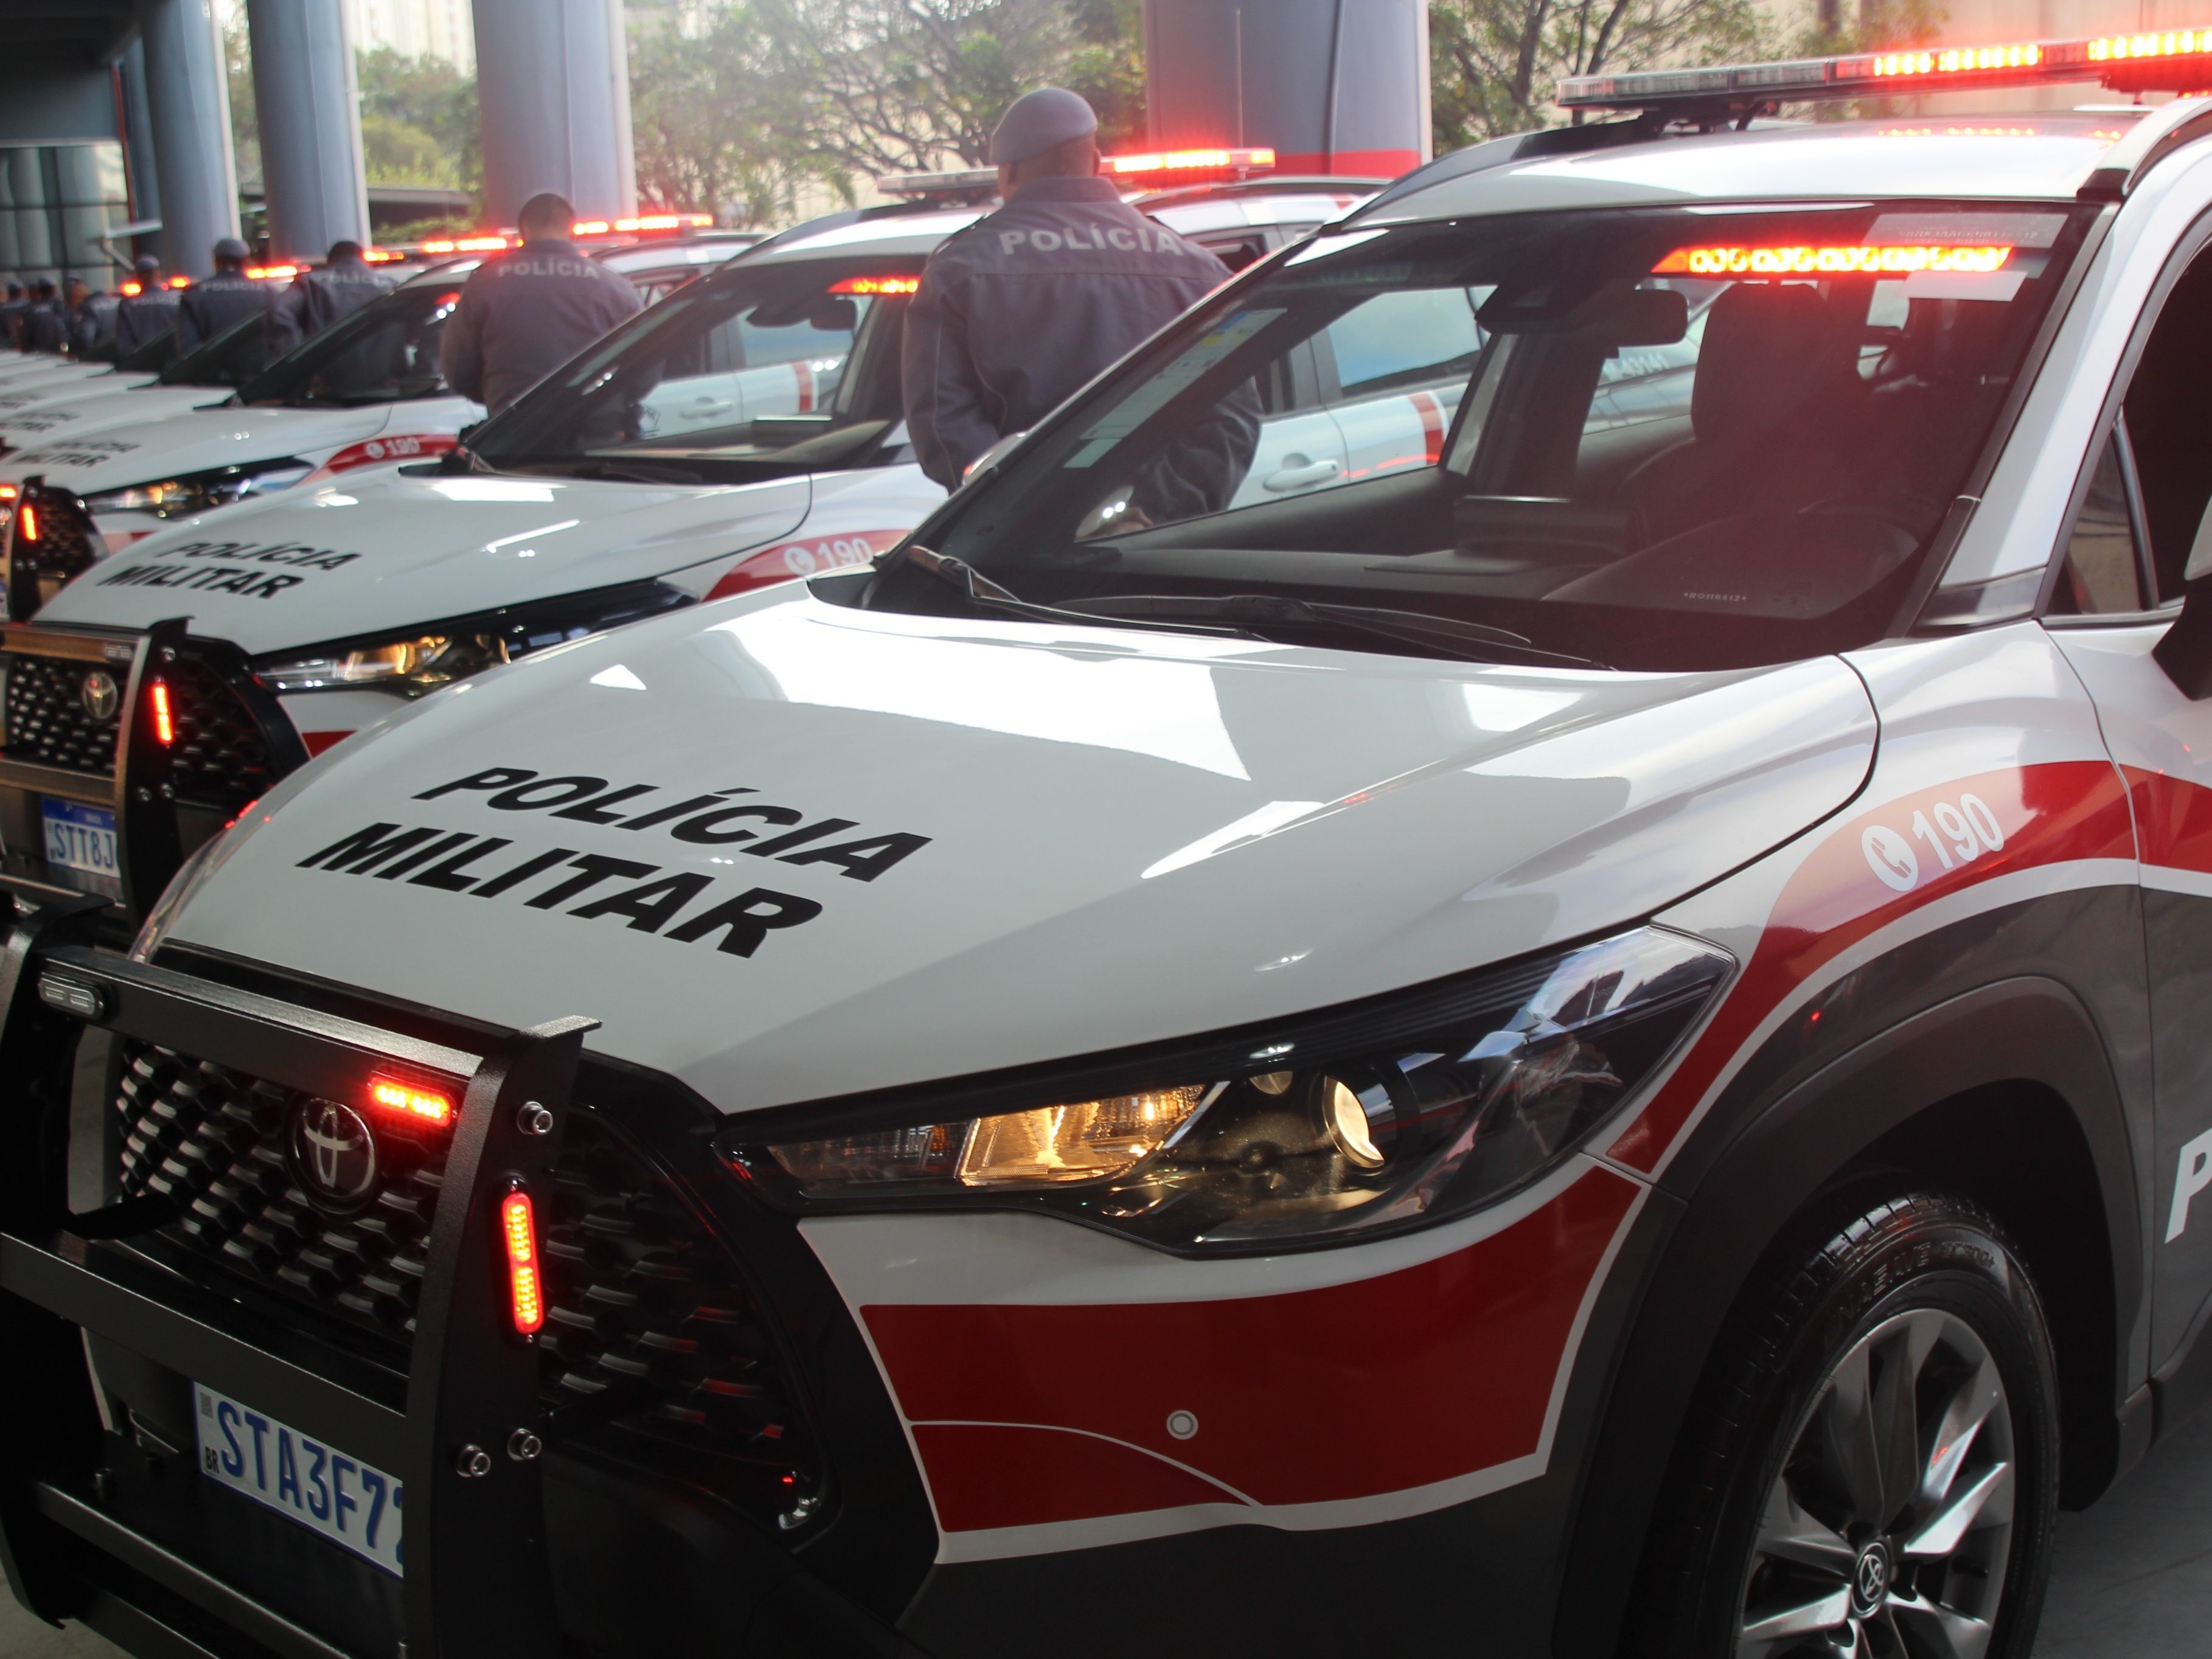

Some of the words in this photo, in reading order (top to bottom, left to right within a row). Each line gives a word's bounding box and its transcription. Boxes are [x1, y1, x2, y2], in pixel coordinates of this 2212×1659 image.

[1000, 223, 1184, 256] POLÍCIA
[498, 255, 599, 279] POLÍCIA
[386, 437, 420, 455] 190
[154, 541, 363, 571] POLÍCIA
[818, 537, 874, 569] 190
[96, 566, 304, 600] MILITAR
[411, 767, 933, 882] POLÍCIA
[1912, 794, 2004, 869] 190
[55, 823, 114, 869] STT8J
[294, 823, 823, 958] MILITAR
[205, 1446, 220, 1473] BR
[218, 1400, 403, 1565] STA3F7
